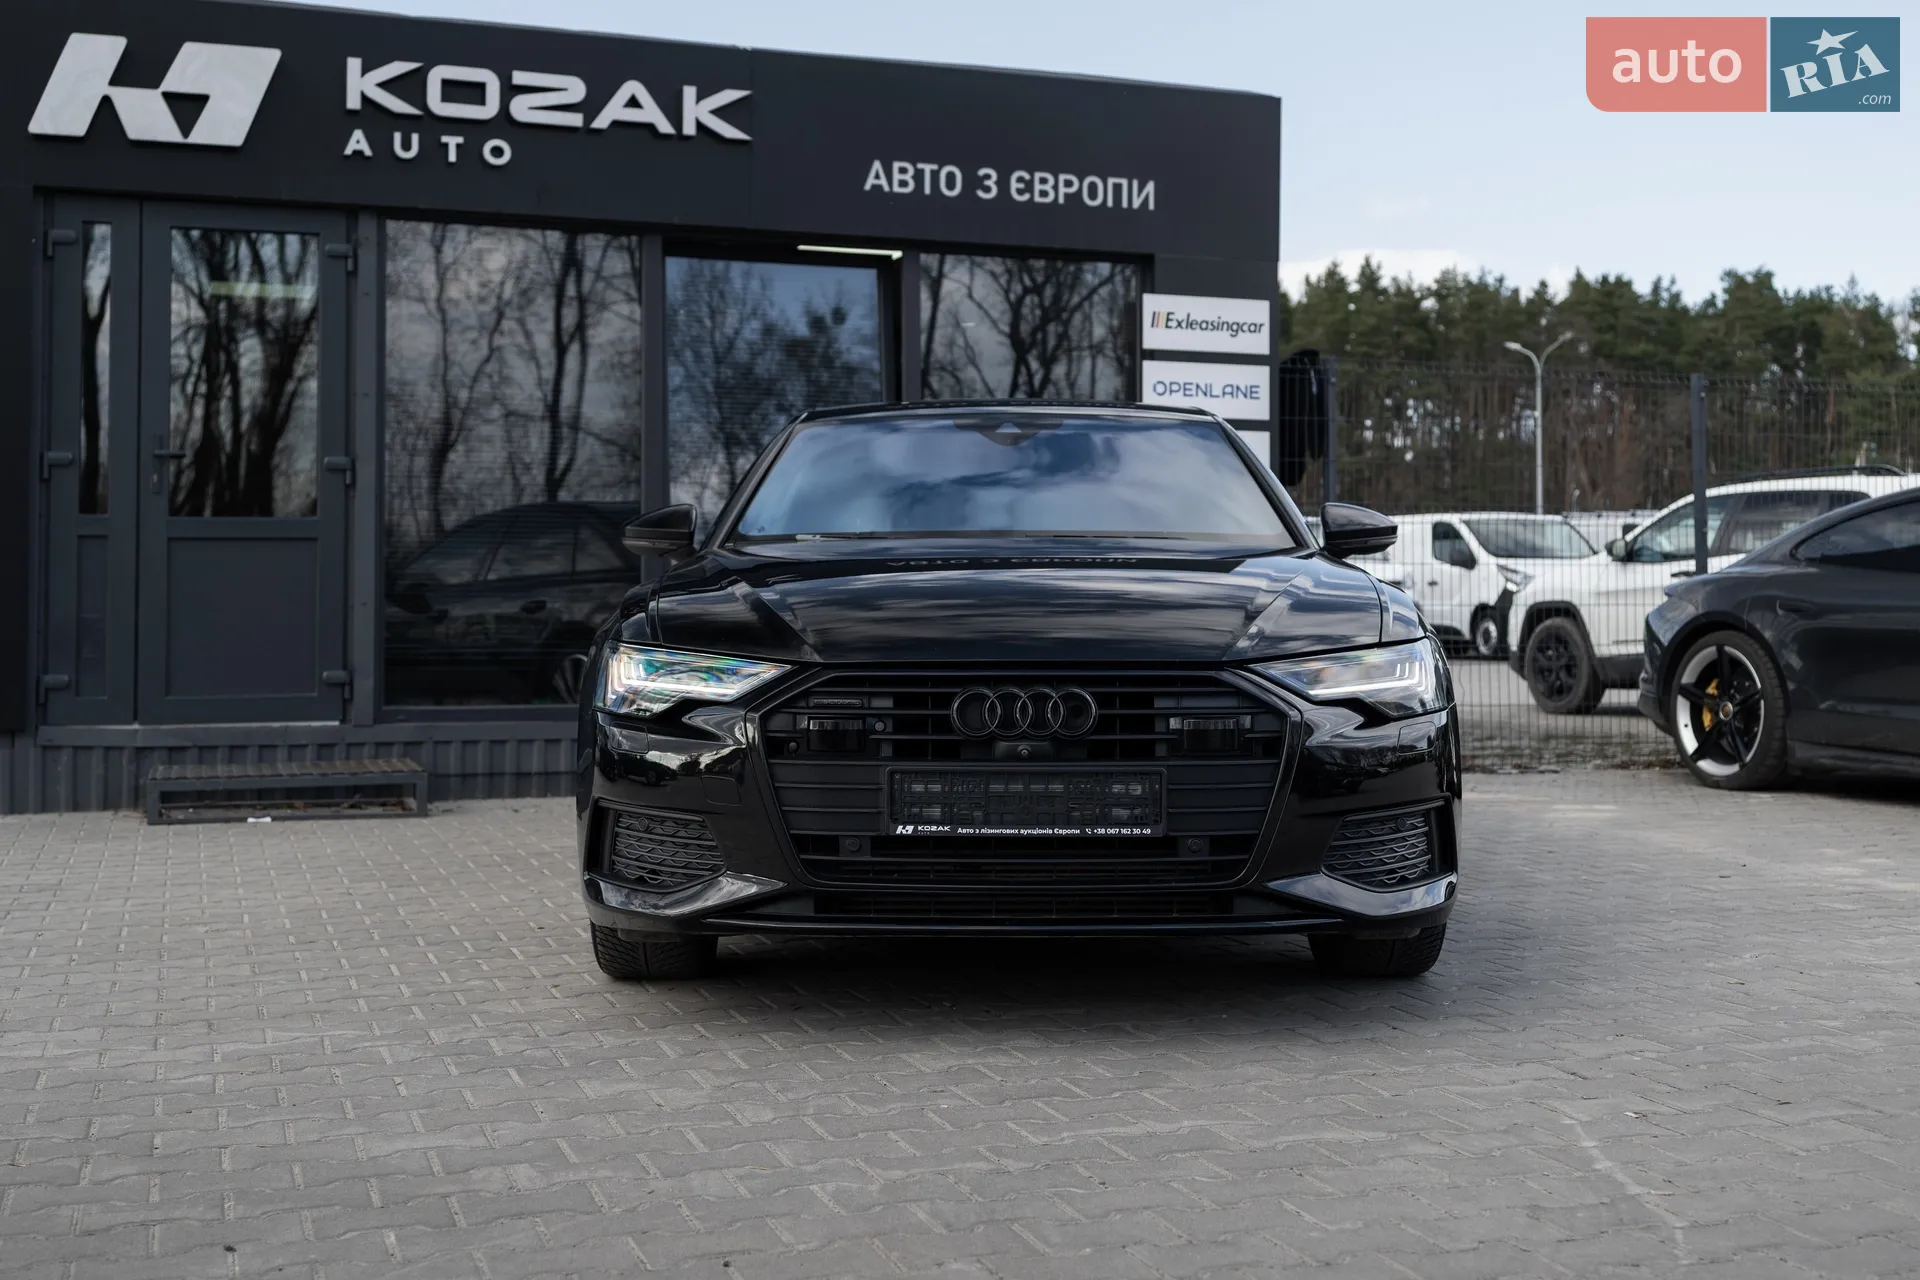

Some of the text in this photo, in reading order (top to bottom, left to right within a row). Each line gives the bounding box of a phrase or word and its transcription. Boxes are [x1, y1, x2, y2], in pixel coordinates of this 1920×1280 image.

[343, 129, 512, 166] AUTO
[863, 159, 963, 198] АВТО
[1009, 170, 1156, 211] ЄВРОПИ
[1164, 311, 1265, 338] Exleasingcar
[1152, 380, 1261, 400] OPENLANE
[1020, 827, 1052, 835] аукціонів
